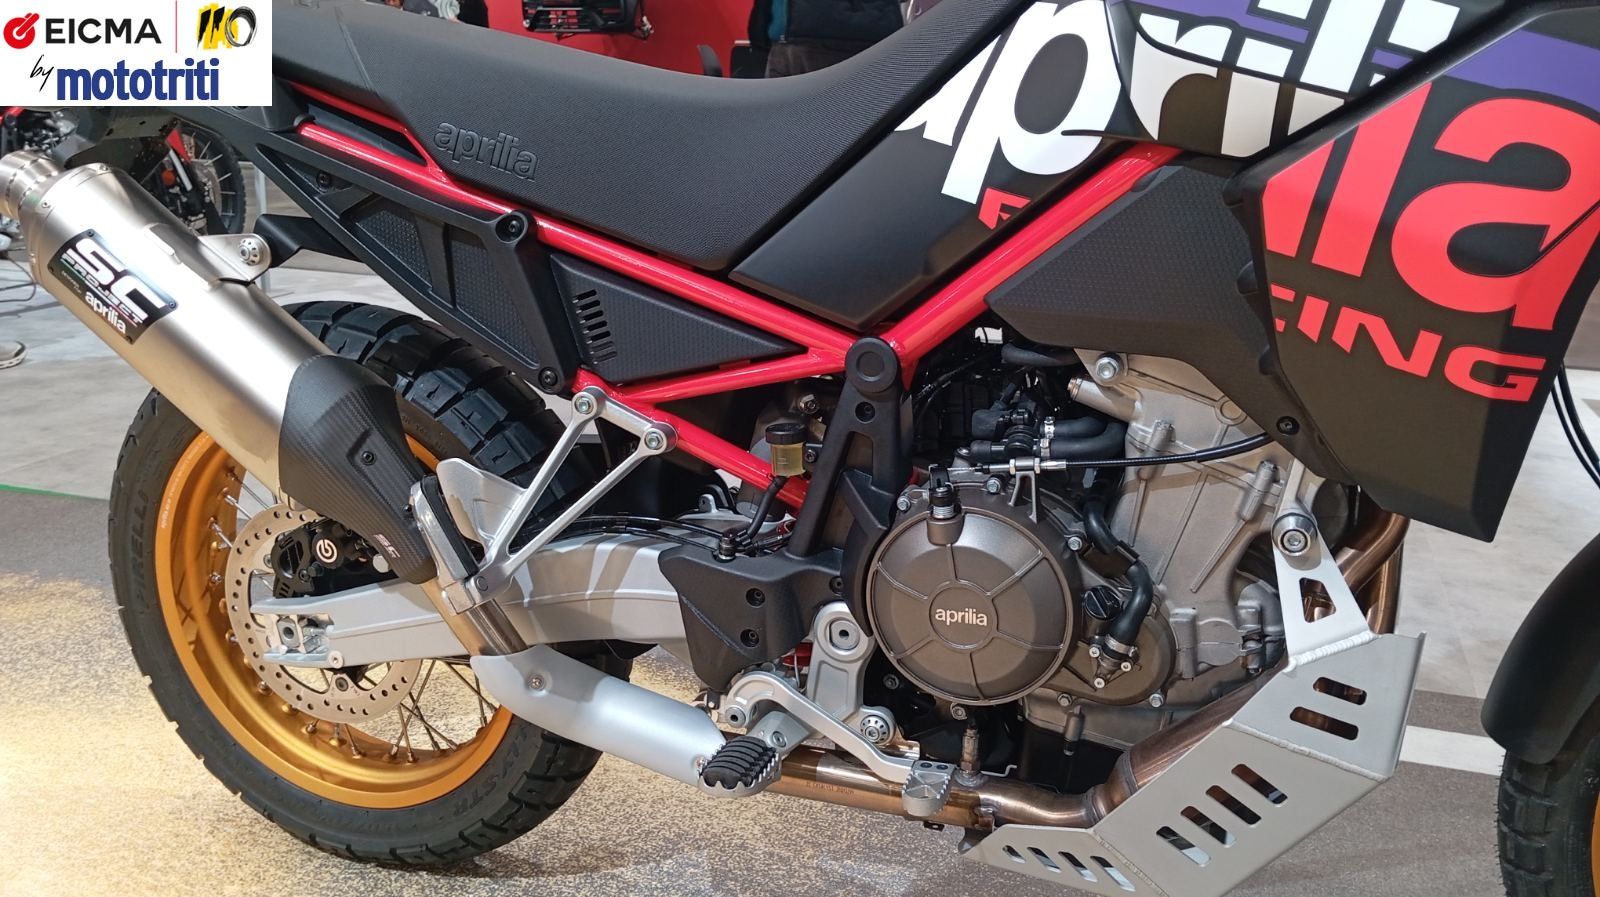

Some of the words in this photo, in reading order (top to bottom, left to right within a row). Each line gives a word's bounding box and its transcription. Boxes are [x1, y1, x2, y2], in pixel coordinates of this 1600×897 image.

[434, 122, 538, 182] aprilia
[85, 291, 126, 334] aprilia
[935, 608, 988, 626] aprilia
